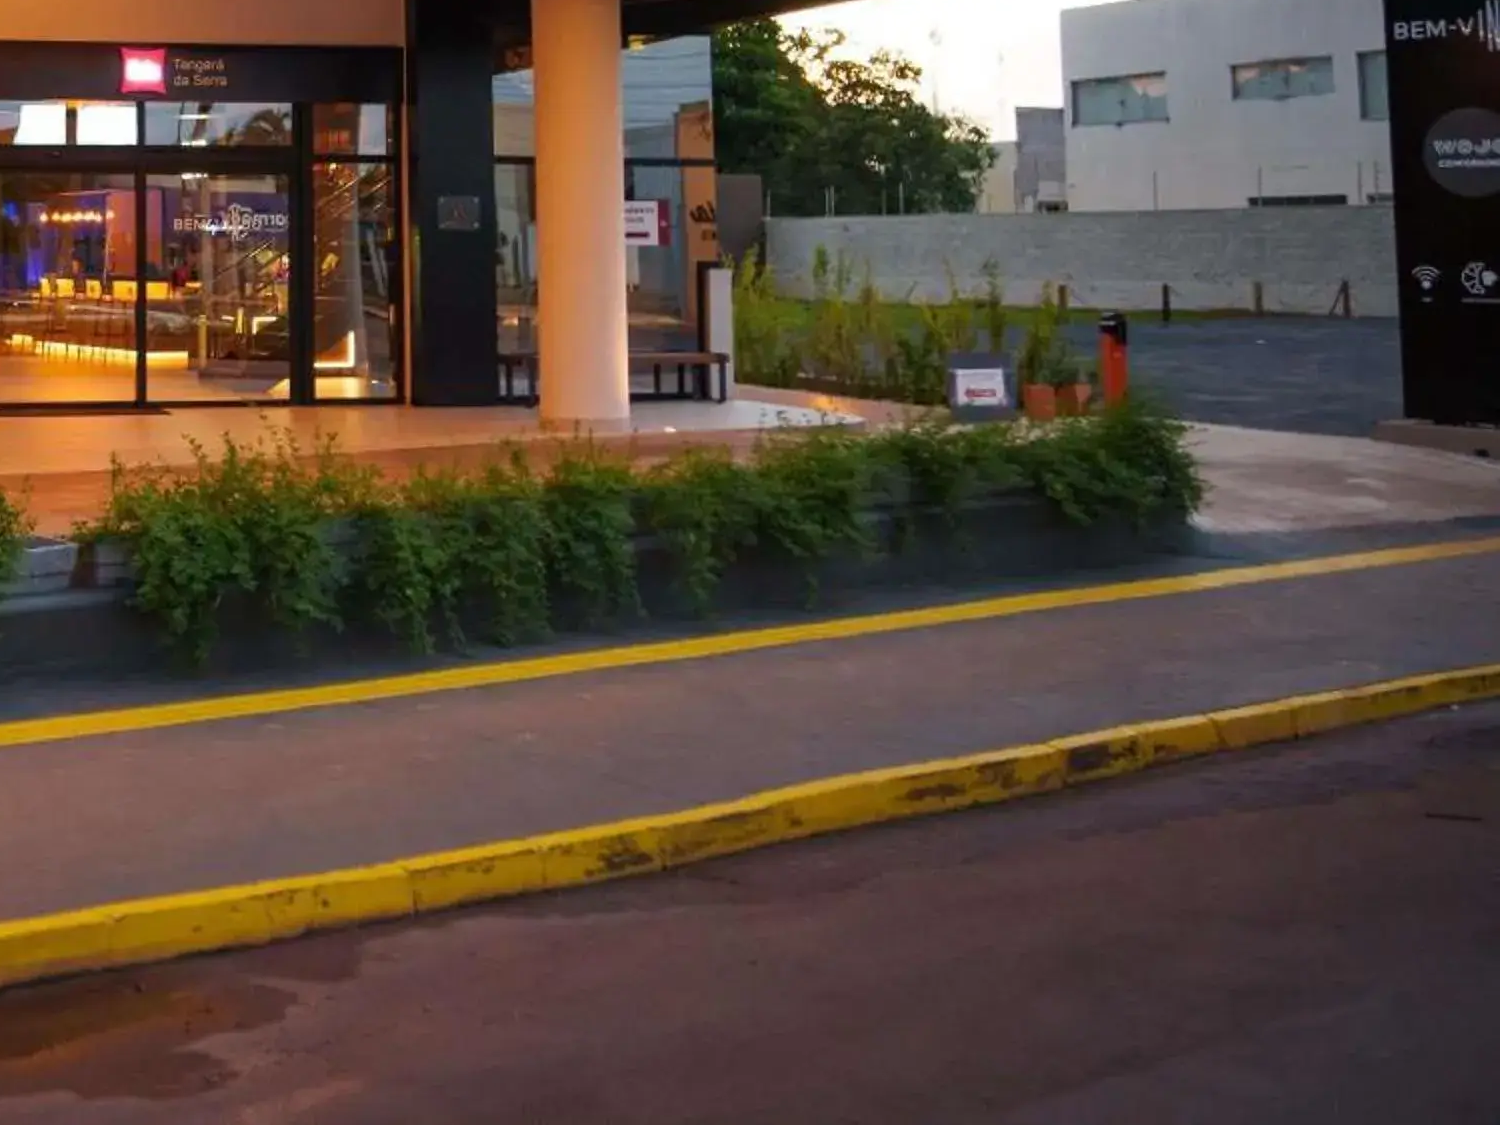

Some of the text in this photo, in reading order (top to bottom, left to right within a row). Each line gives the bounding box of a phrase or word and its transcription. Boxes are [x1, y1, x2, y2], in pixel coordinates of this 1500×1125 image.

[173, 58, 225, 74] Tangará
[173, 75, 228, 87] da Serra
